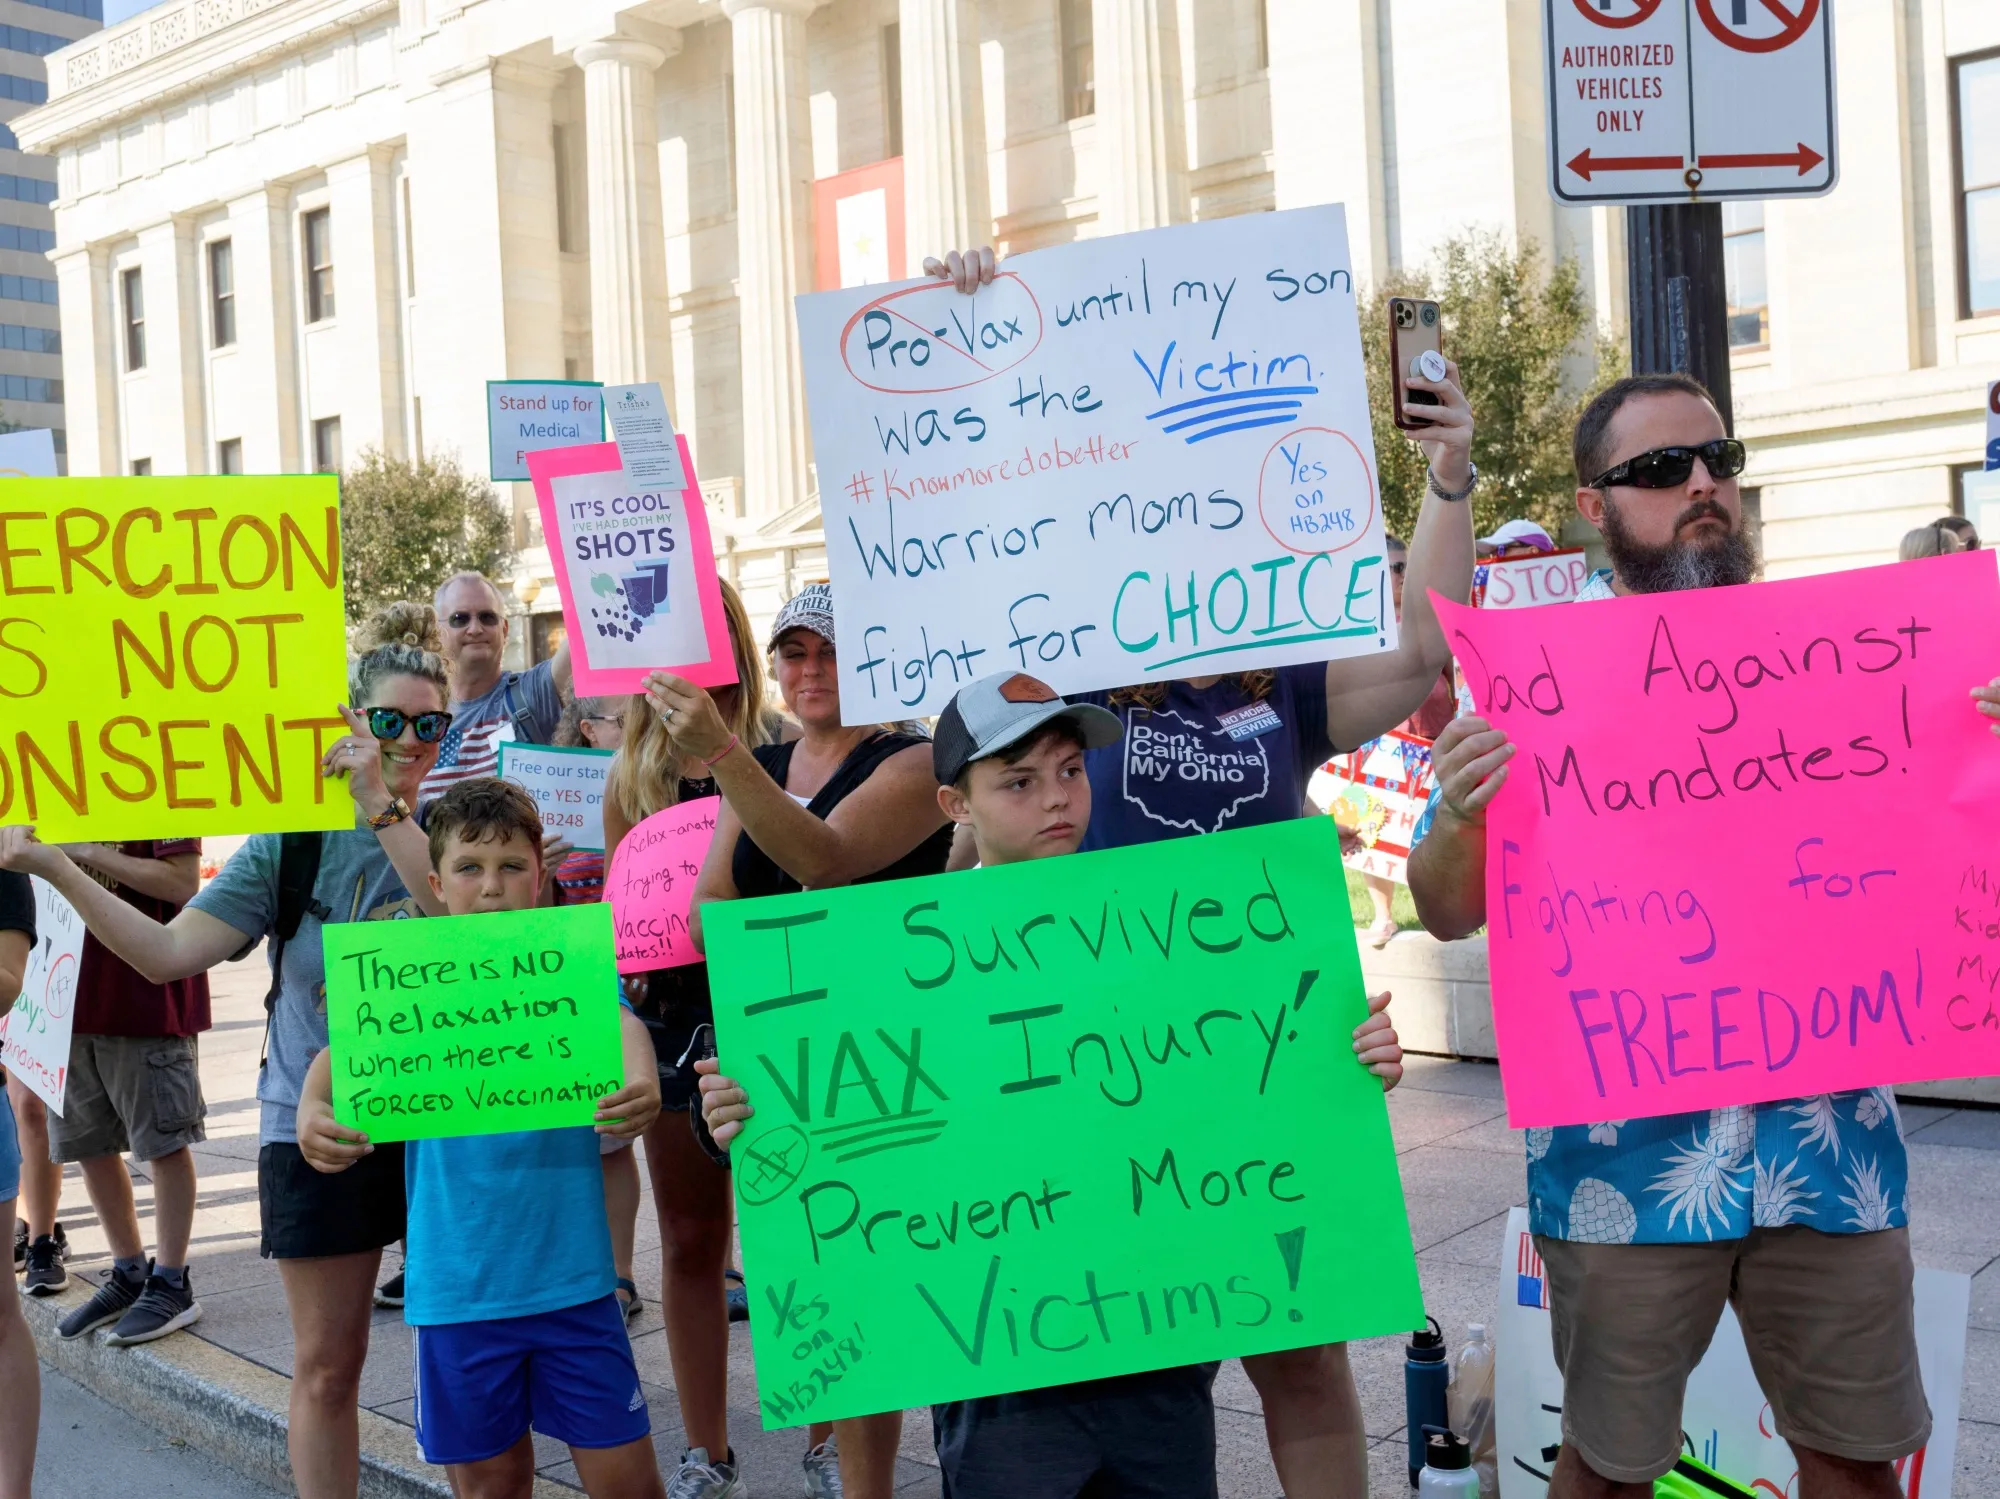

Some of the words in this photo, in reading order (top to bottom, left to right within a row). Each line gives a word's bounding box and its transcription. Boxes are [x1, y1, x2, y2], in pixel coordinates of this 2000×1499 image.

[1562, 44, 1674, 68] AUTHORIZED
[1576, 77, 1663, 100] VEHICLES
[1596, 110, 1644, 132] ONLY
[864, 299, 1023, 370] Pro-Vax
[1055, 259, 1151, 329] until
[1173, 276, 1237, 340] my
[1266, 264, 1351, 301] son
[499, 395, 547, 411] Stand
[552, 397, 569, 414] up
[573, 396, 594, 412] for
[1009, 375, 1103, 419] the
[520, 422, 581, 439] Medical
[1280, 442, 1328, 485] Yes
[570, 500, 606, 520] IT'S
[611, 493, 671, 513] COOL
[1296, 488, 1324, 509] on
[572, 521, 593, 533] I'VE
[596, 518, 620, 531] HAD
[622, 515, 653, 529] BOTH
[656, 512, 673, 525] MY
[849, 497, 1057, 581] Warrior
[1291, 508, 1356, 535] HB248
[0, 505, 339, 600] ERCION
[575, 527, 676, 561] SHOTS
[1490, 559, 1587, 607] STOP
[857, 625, 987, 707] fight
[1008, 593, 1097, 670] for
[1112, 552, 1386, 653] CHOICE!
[113, 611, 304, 700] NOT
[1643, 613, 1932, 734] Against
[1221, 714, 1239, 726] NO
[1238, 703, 1272, 720] MORE
[1229, 714, 1281, 739] DEWINE
[1131, 739, 1263, 767] California
[1132, 725, 1205, 750] Don't
[1534, 684, 1914, 818] Mandates!
[511, 758, 542, 775] Free
[546, 766, 573, 777] our
[1130, 755, 1172, 781] My
[1178, 762, 1245, 782] Ohio
[524, 786, 551, 801] ote
[555, 788, 582, 803] YES
[623, 868, 674, 899] trying
[678, 860, 699, 877] to
[1502, 836, 1718, 979] Fighting
[1788, 836, 1897, 900] for
[615, 937, 674, 961] dates!!
[743, 908, 830, 1018] I
[902, 857, 1296, 991] Survived
[340, 948, 461, 993] There
[511, 950, 565, 980] NO
[356, 990, 579, 1037] Relaxation
[1568, 948, 1928, 1099] FREEDOM!
[443, 1041, 534, 1070] there
[547, 1034, 573, 1059] is
[756, 1026, 953, 1125] VAX
[987, 969, 1321, 1108] Injury!
[348, 1087, 454, 1123] FORCED
[465, 1072, 620, 1110] Vaccination
[798, 1177, 1073, 1265] Prevent
[1128, 1147, 1306, 1217] More
[764, 1278, 831, 1339] Yes
[914, 1226, 1308, 1368] Victims!
[791, 1326, 835, 1362] on
